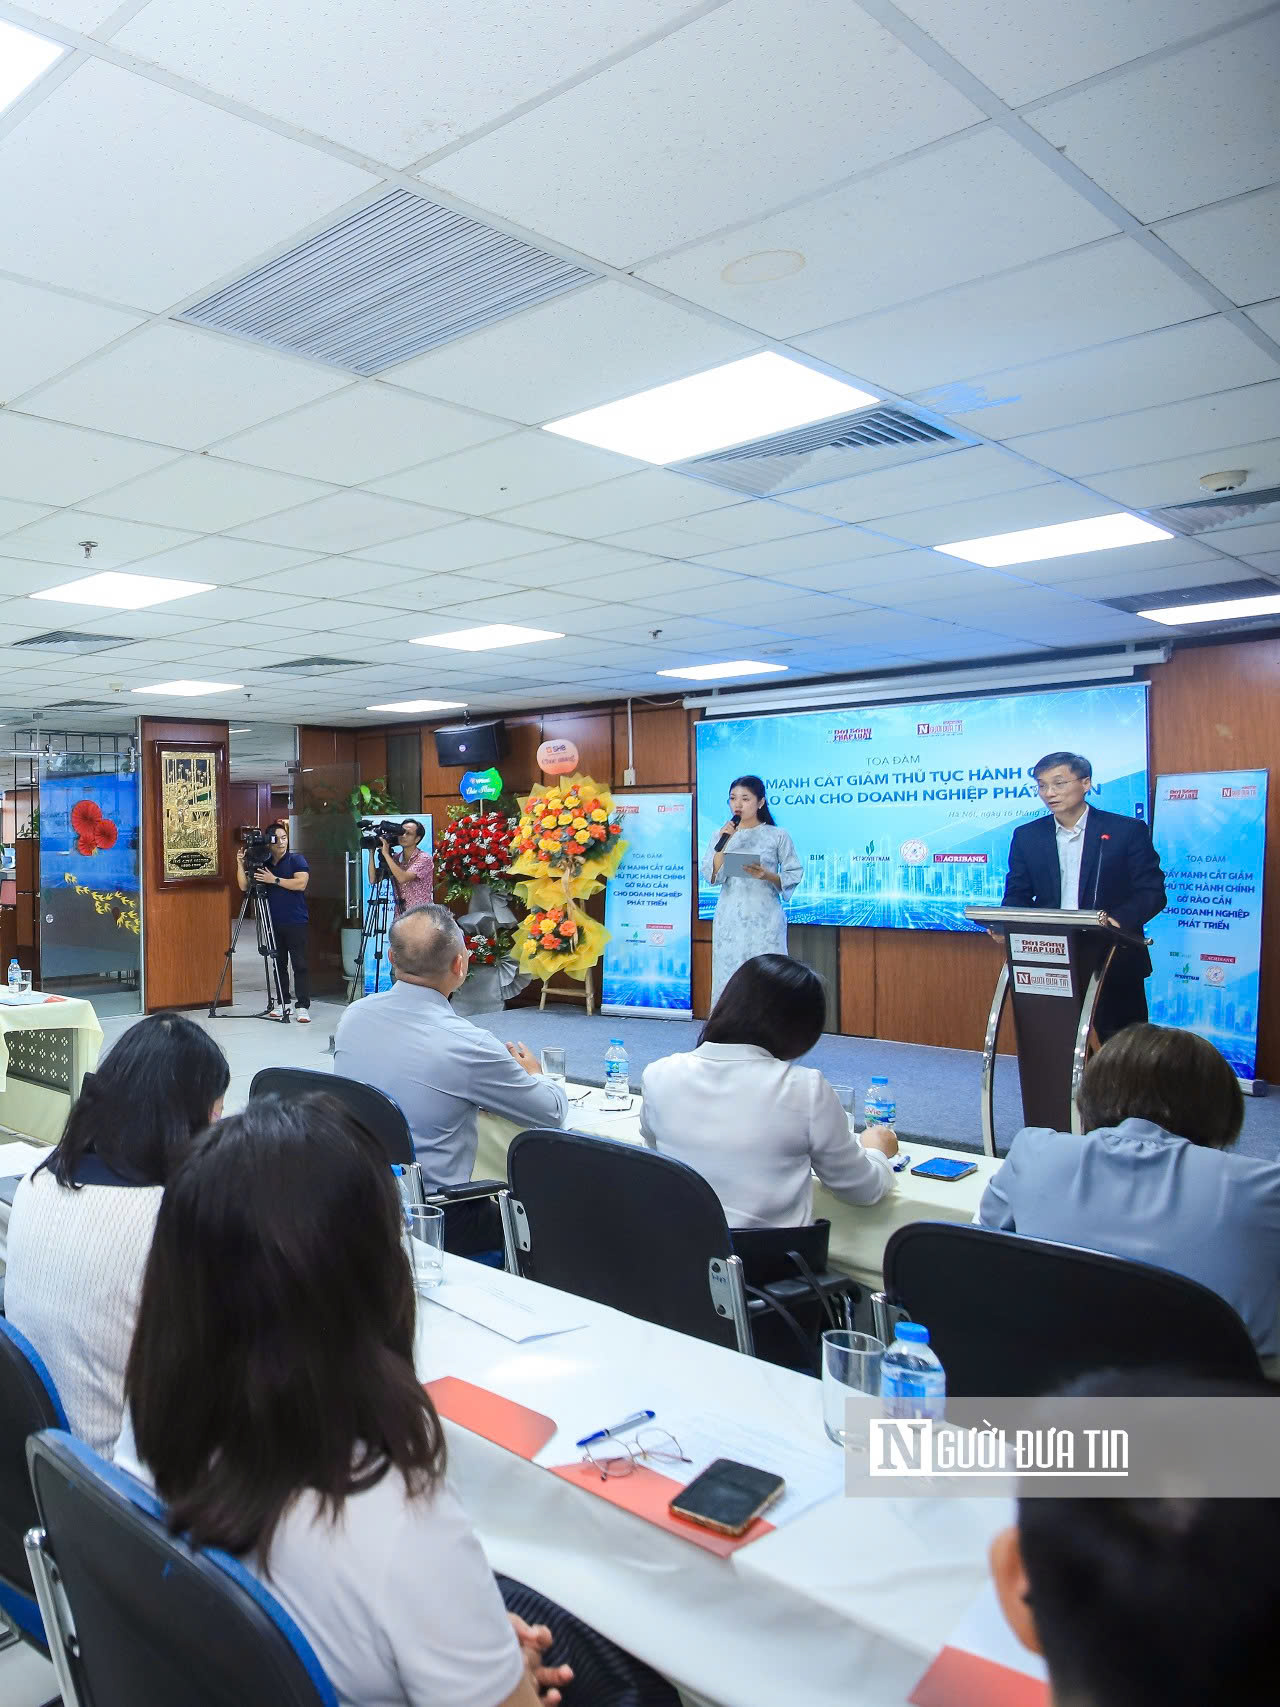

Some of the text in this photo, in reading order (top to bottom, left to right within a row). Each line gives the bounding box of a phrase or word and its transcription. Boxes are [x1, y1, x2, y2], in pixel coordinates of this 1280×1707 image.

[766, 776, 810, 792] MẠNH
[846, 770, 888, 786] GIẢM
[892, 768, 926, 783] THỦ
[929, 769, 964, 785] TỤC
[969, 765, 1022, 781] HÀNH
[819, 792, 853, 804] CHO
[857, 790, 918, 803] DOANH
[923, 784, 988, 803] NGHIỆP
[943, 855, 985, 863] AGRIBANK
[1164, 880, 1177, 890] HỦ
[1195, 882, 1224, 893] HÀNH
[1225, 882, 1256, 894] CHÍNH
[1180, 907, 1214, 917] DOANH
[1215, 908, 1250, 920] NGHIỆP
[1177, 918, 1201, 928] PHÁT
